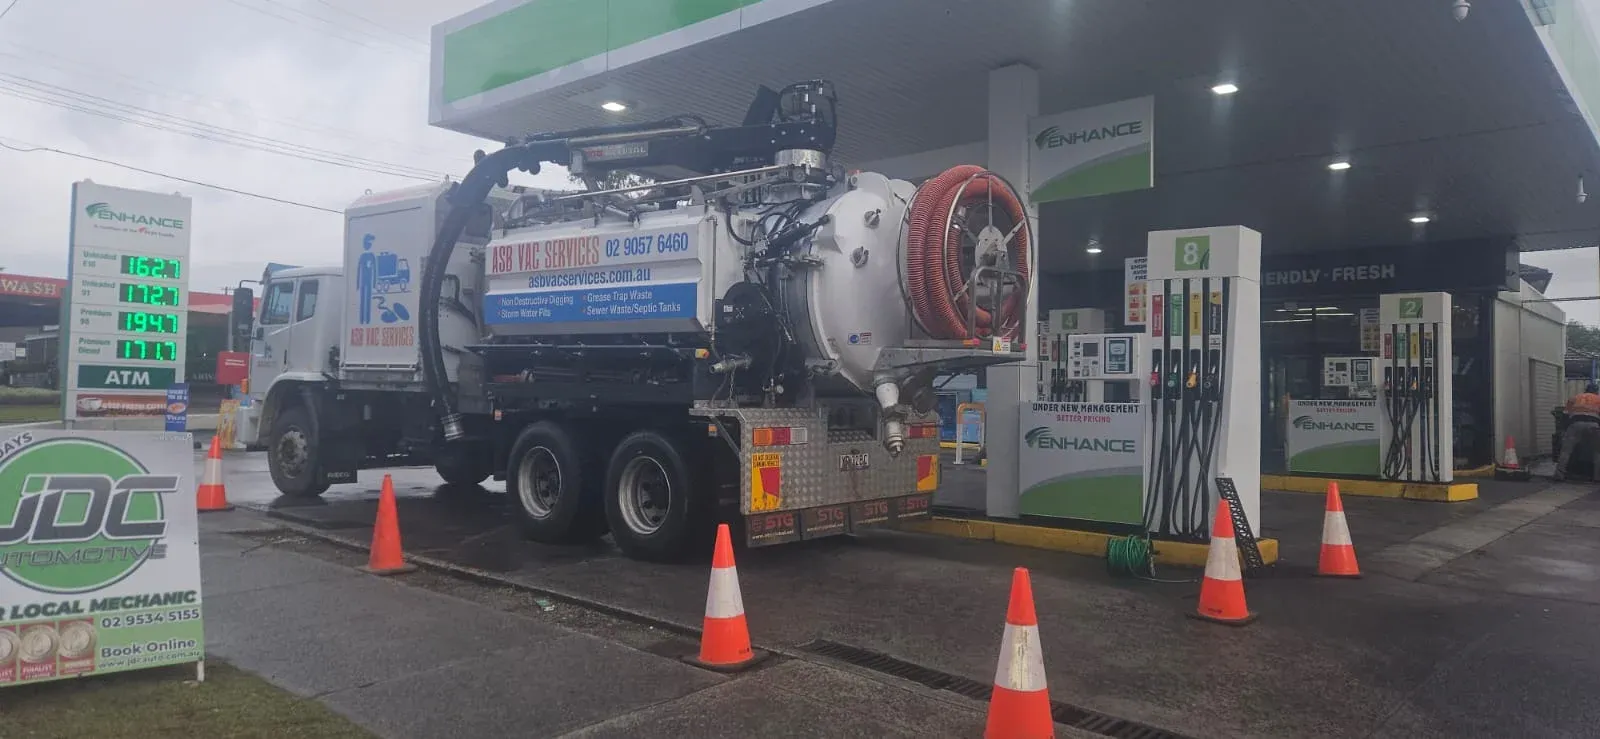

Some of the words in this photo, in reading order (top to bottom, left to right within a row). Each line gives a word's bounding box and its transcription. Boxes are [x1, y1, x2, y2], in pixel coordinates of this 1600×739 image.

[1047, 120, 1142, 149] ENHANCE
[98, 209, 184, 229] ENHANCE
[492, 244, 513, 273] ASB
[518, 241, 540, 271] VAC
[545, 236, 600, 269] SERVICES
[605, 239, 620, 257] 02
[624, 236, 653, 256] 9057
[657, 232, 689, 252] 6460
[1183, 241, 1198, 265] 8
[129, 256, 180, 279] 162.7
[1332, 264, 1395, 281] FRESH
[528, 268, 651, 288] asbvacservices.com.au
[2, 279, 57, 296] WASH
[127, 284, 179, 306] 172.7
[587, 293, 611, 302] Grease
[613, 291, 629, 302] Trap
[630, 290, 653, 300] Waste
[549, 294, 574, 305] Digging
[1405, 301, 1417, 315] 2
[501, 309, 519, 318] Storm
[587, 306, 609, 316] Sewer
[610, 303, 657, 315] Waste/Septic
[659, 302, 681, 312] Tanks
[126, 312, 178, 333] 194.7
[351, 327, 363, 346] ASB
[366, 327, 380, 346] VAC
[381, 326, 414, 346] SERVICES
[125, 340, 177, 361] 171.7
[104, 370, 150, 385] ATM
[1032, 403, 1059, 412] UNDER
[1081, 404, 1140, 414] MANAGEMENT
[1056, 414, 1082, 423] BETTER
[1083, 415, 1111, 423] PRICING
[1303, 421, 1375, 431] ENHANCE
[1038, 436, 1136, 453] ENHANCE
[817, 508, 845, 521] STG
[864, 500, 888, 516] STG
[766, 513, 794, 528] STG
[10, 600, 84, 619] LOCAL
[89, 590, 197, 612] MECHANIC
[102, 617, 121, 628] 02
[126, 613, 163, 626] 9534
[168, 609, 200, 621] 5155
[101, 643, 142, 658] Book
[146, 638, 196, 652] Online
